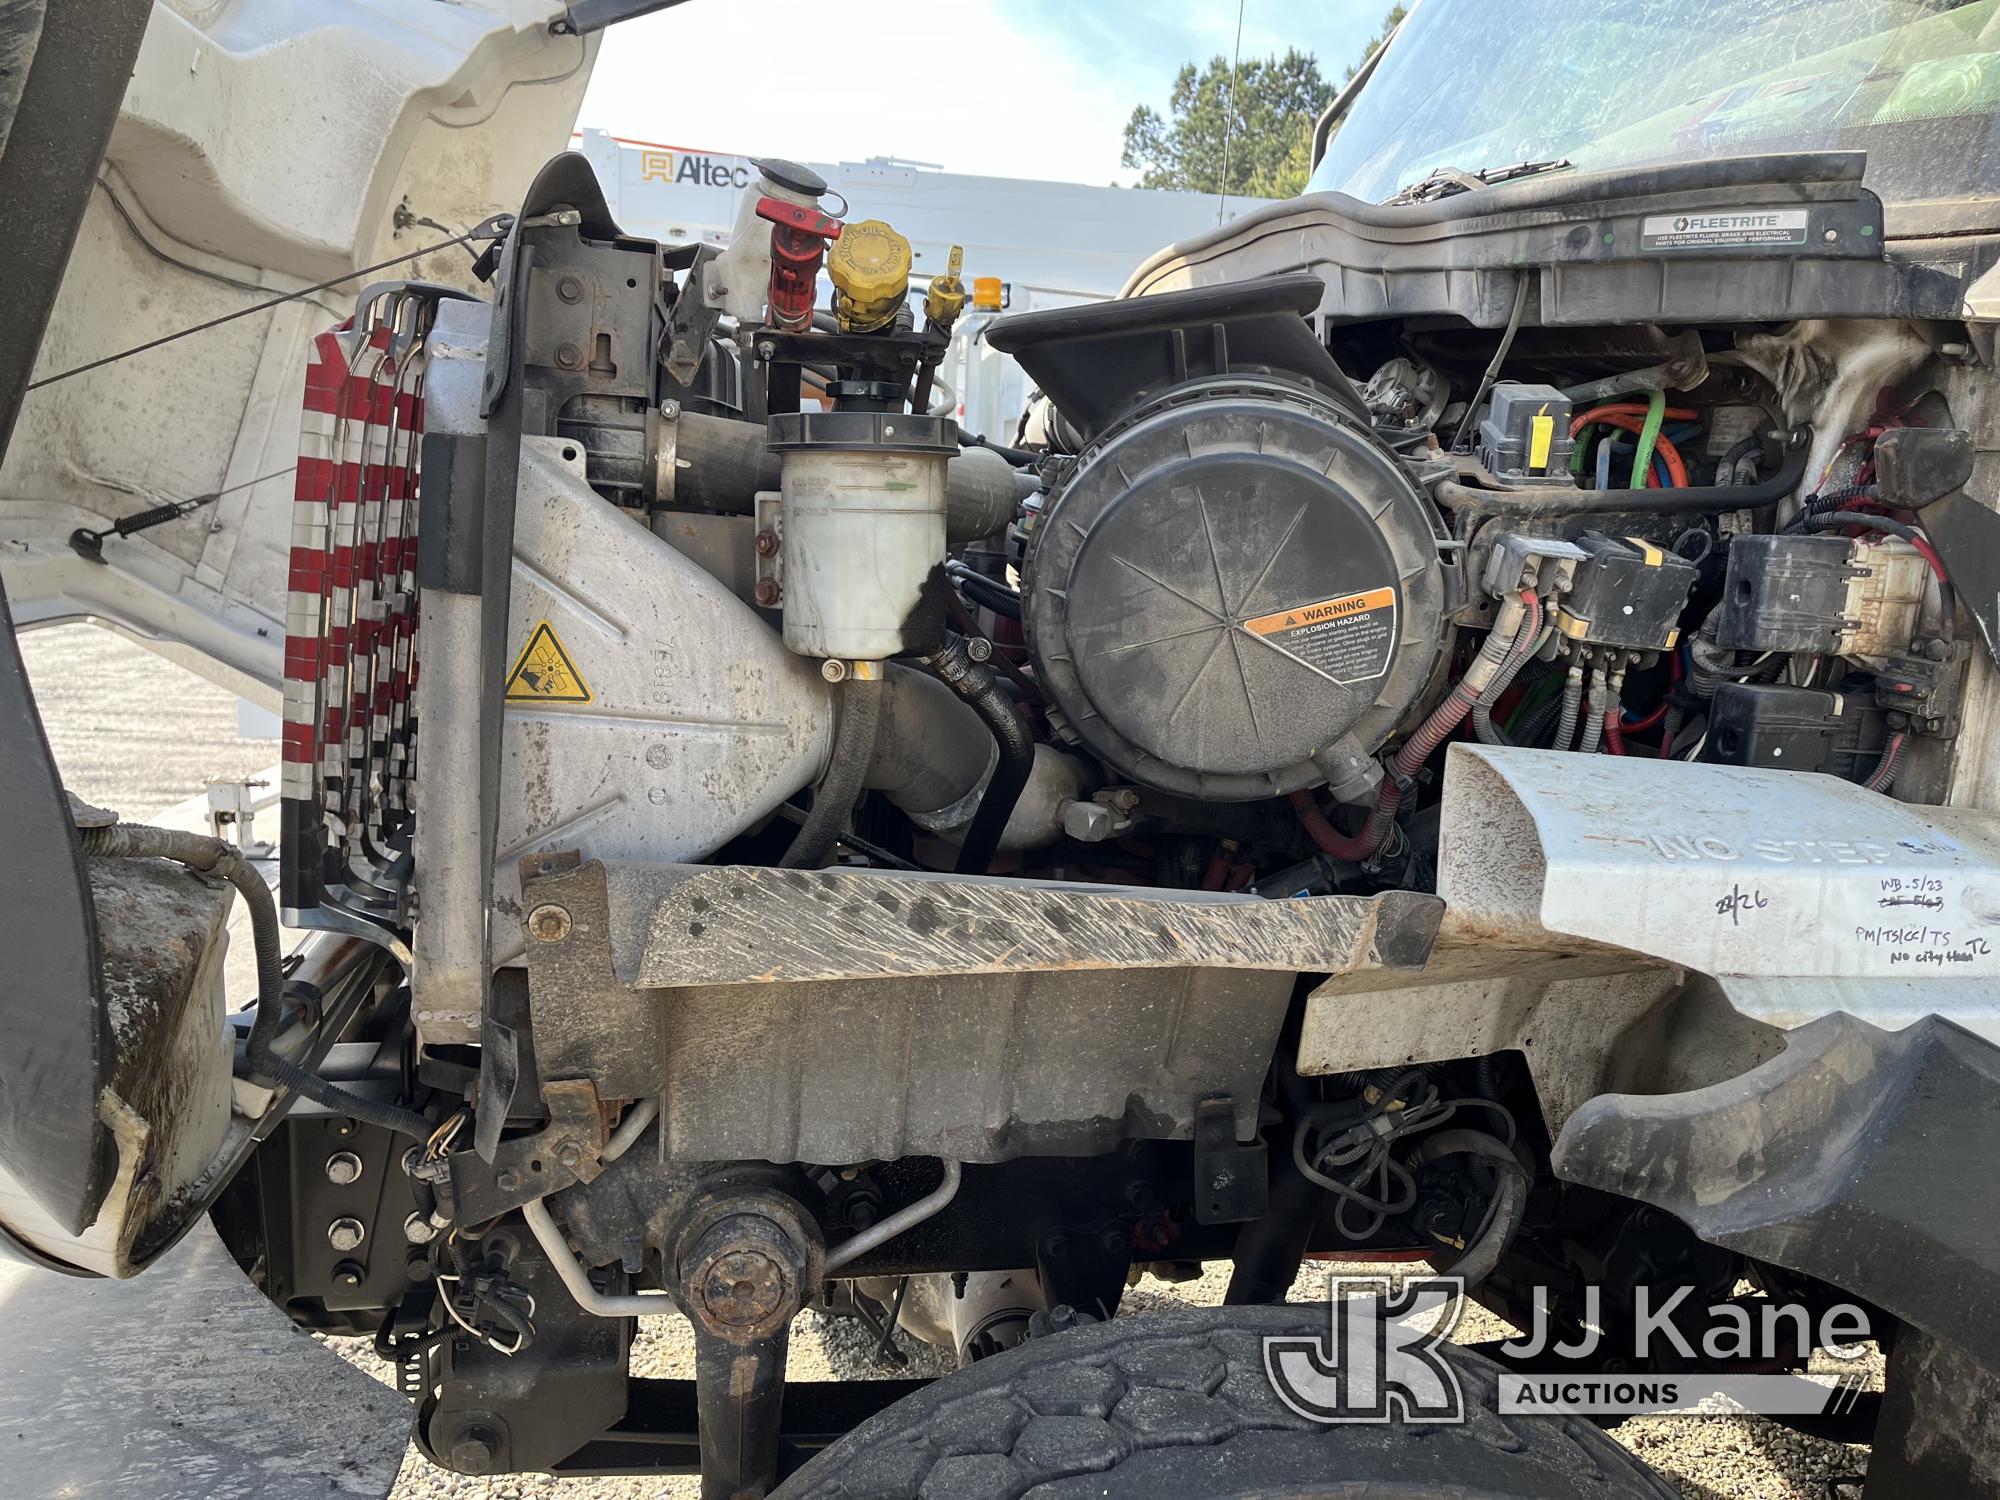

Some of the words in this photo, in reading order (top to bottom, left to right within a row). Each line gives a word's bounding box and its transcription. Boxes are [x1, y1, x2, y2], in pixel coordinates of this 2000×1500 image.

[676, 155, 749, 189] Altec
[1689, 214, 1778, 230] FLEETRITE
[861, 226, 879, 235] OIL
[1669, 233, 1698, 241] FLEETRITE
[1748, 235, 1792, 243] PERFORMANCE
[1303, 599, 1366, 621] WARNING
[1290, 621, 1336, 637] EXPLOSION
[1337, 613, 1371, 627] HAZARD
[1328, 627, 1347, 637] starting
[1370, 625, 1388, 634] engine
[653, 636, 674, 704] 7E819
[1650, 834, 1742, 862] NO
[1751, 838, 1892, 864] STEP
